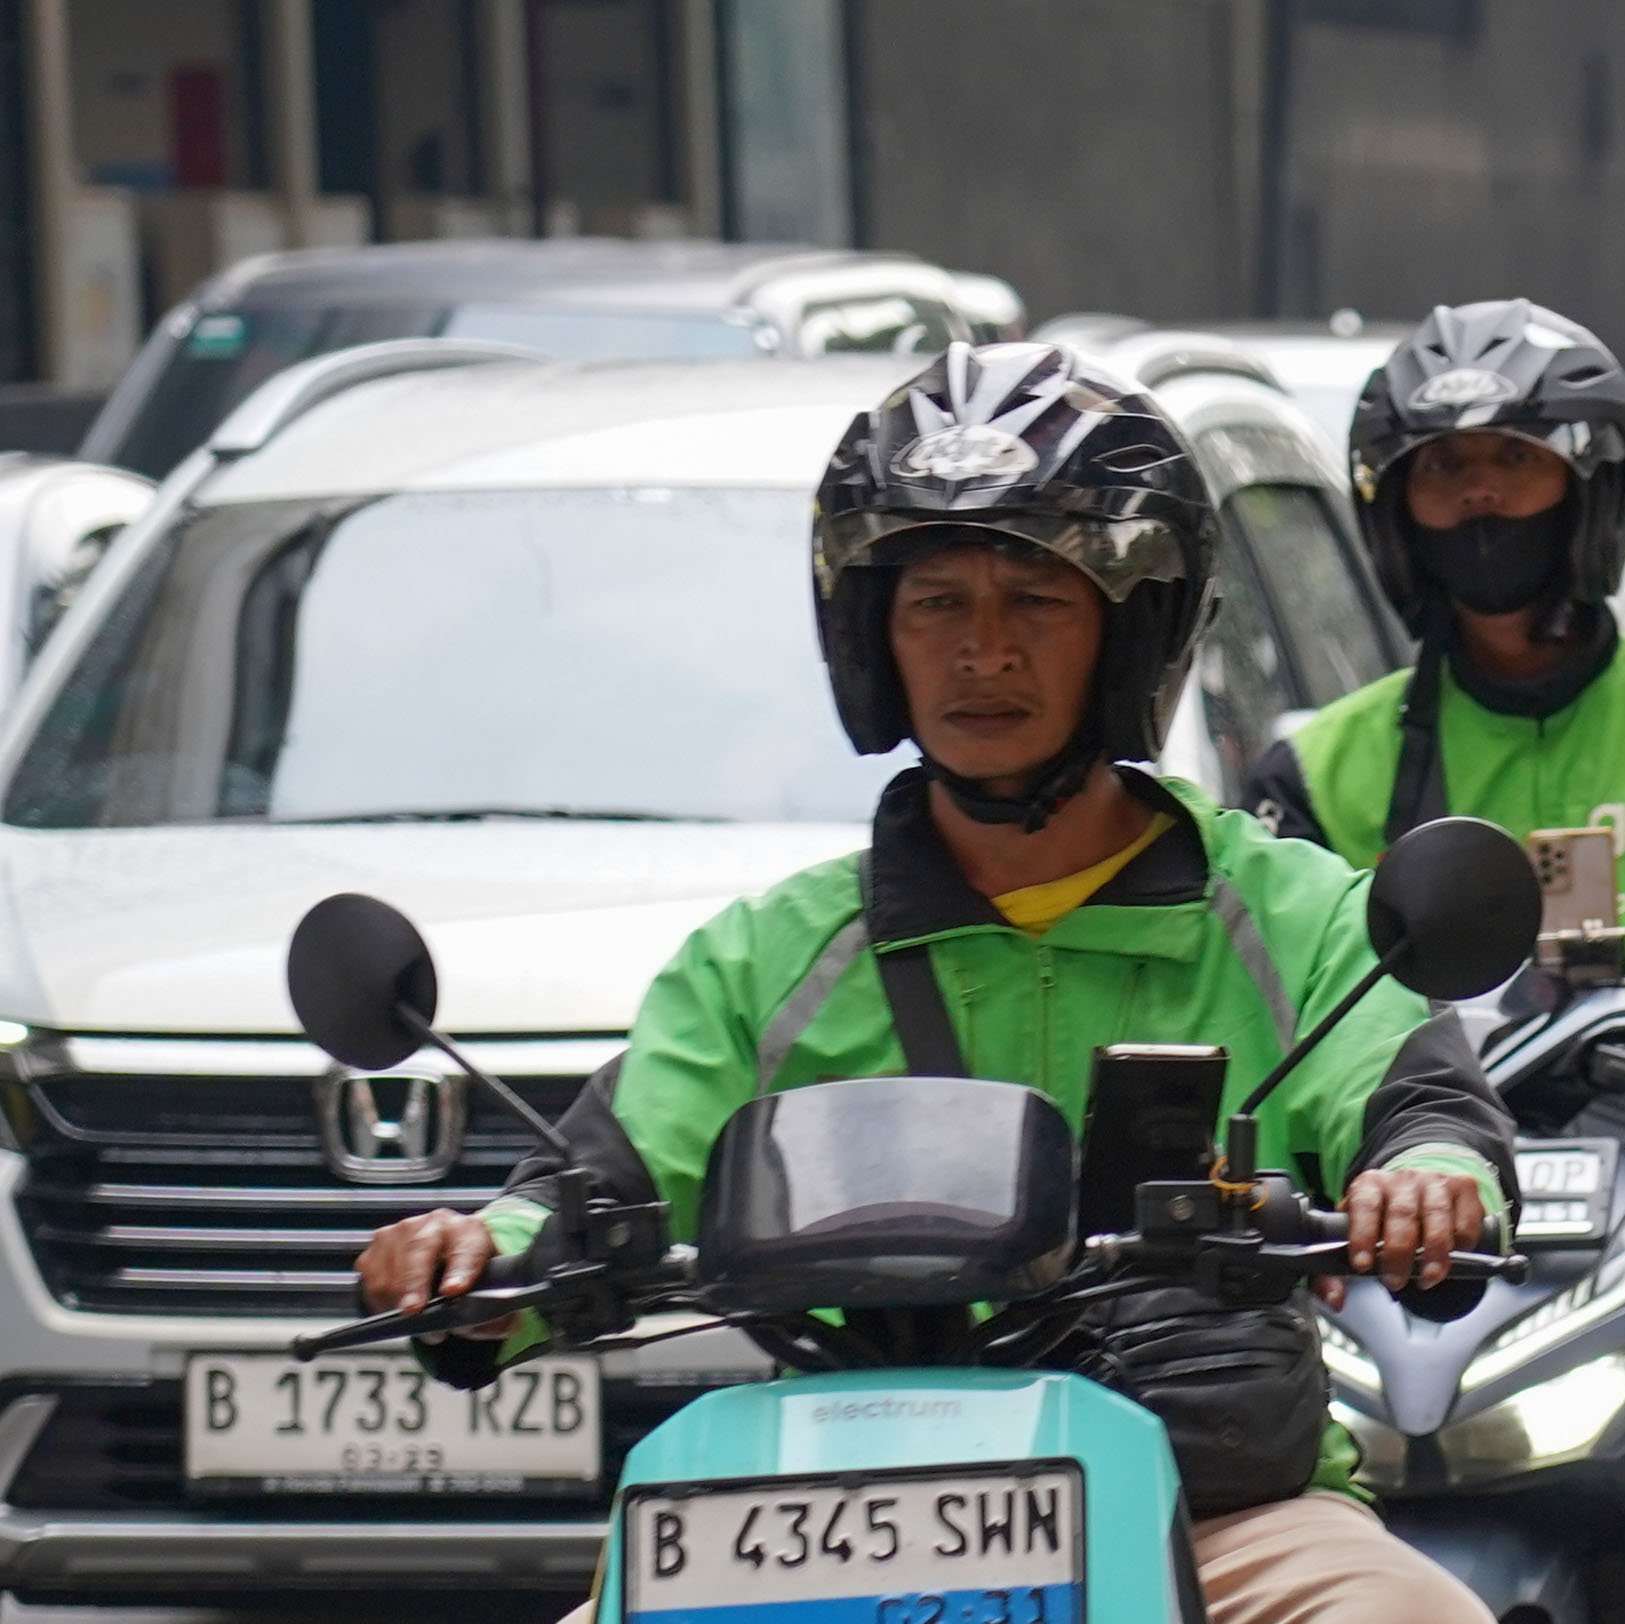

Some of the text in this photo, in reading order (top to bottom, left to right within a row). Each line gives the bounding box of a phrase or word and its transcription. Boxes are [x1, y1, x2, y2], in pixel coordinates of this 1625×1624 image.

[206, 1369, 237, 1431] B
[276, 1370, 428, 1432] 1733
[812, 1396, 962, 1423] electrum
[653, 1487, 1061, 1579] B 4345 SWN
